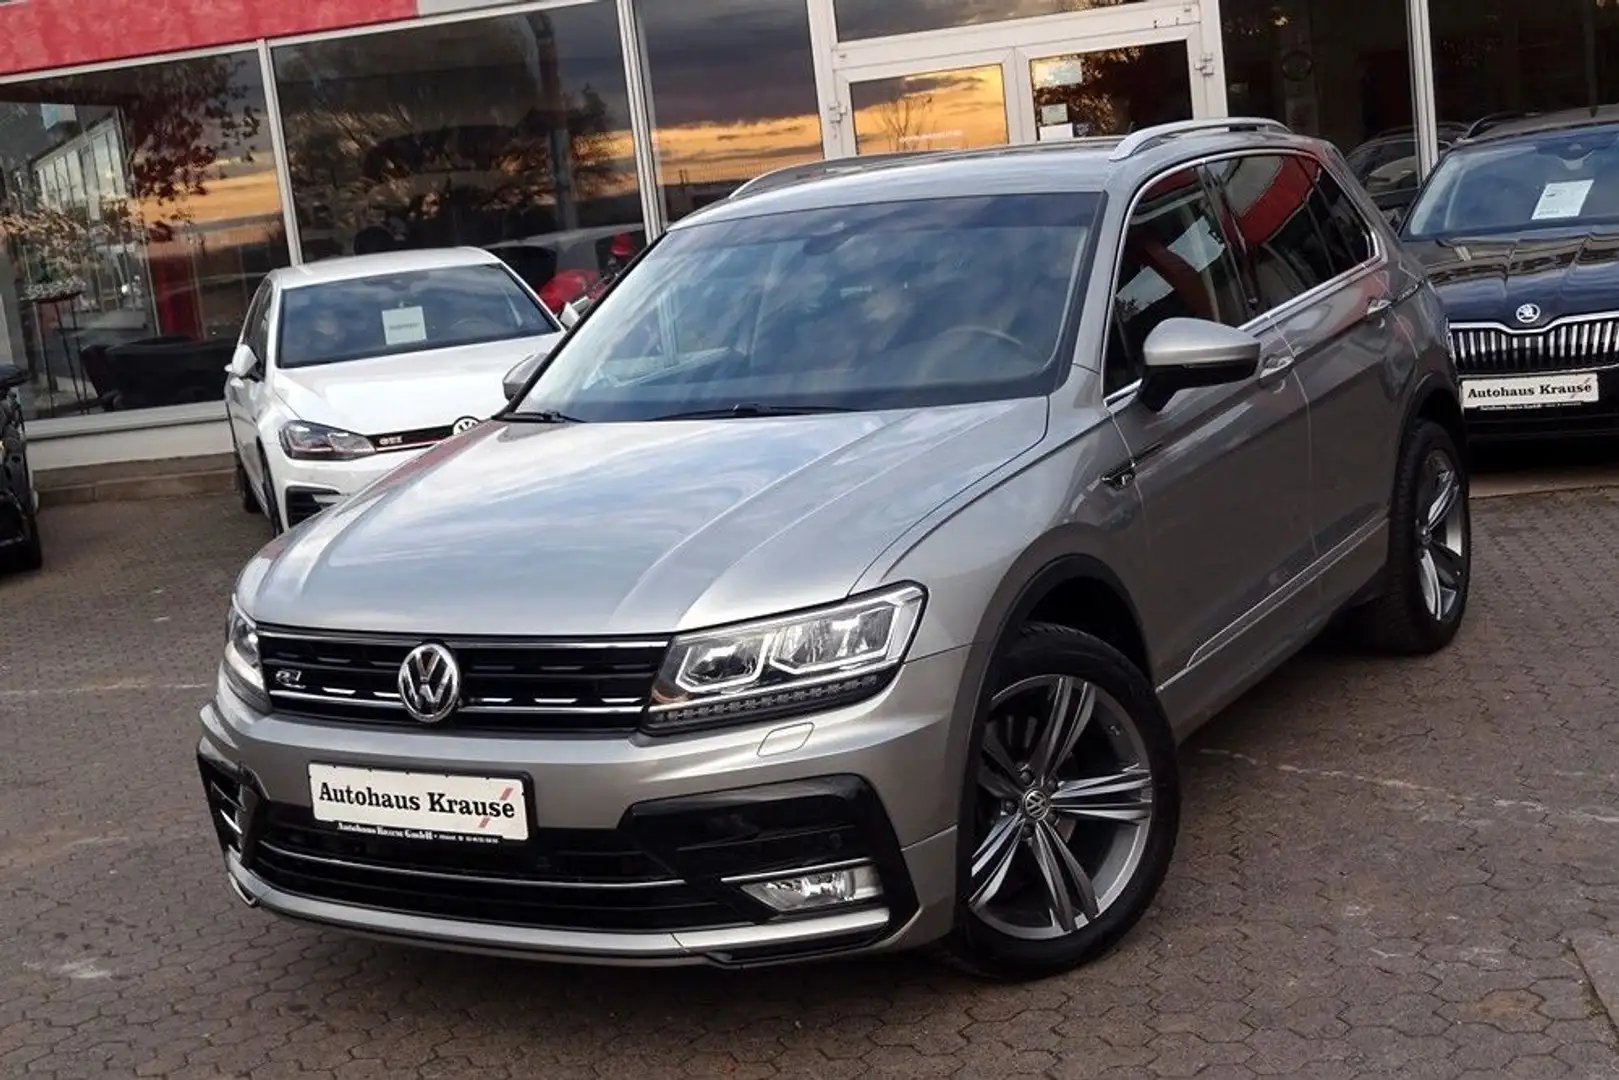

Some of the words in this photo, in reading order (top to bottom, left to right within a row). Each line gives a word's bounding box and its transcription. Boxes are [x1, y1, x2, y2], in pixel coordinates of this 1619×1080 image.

[1467, 386, 1535, 399] Autohaus
[1540, 383, 1592, 396] Krause
[319, 781, 421, 811] Autohaus
[427, 791, 515, 819] Krause
